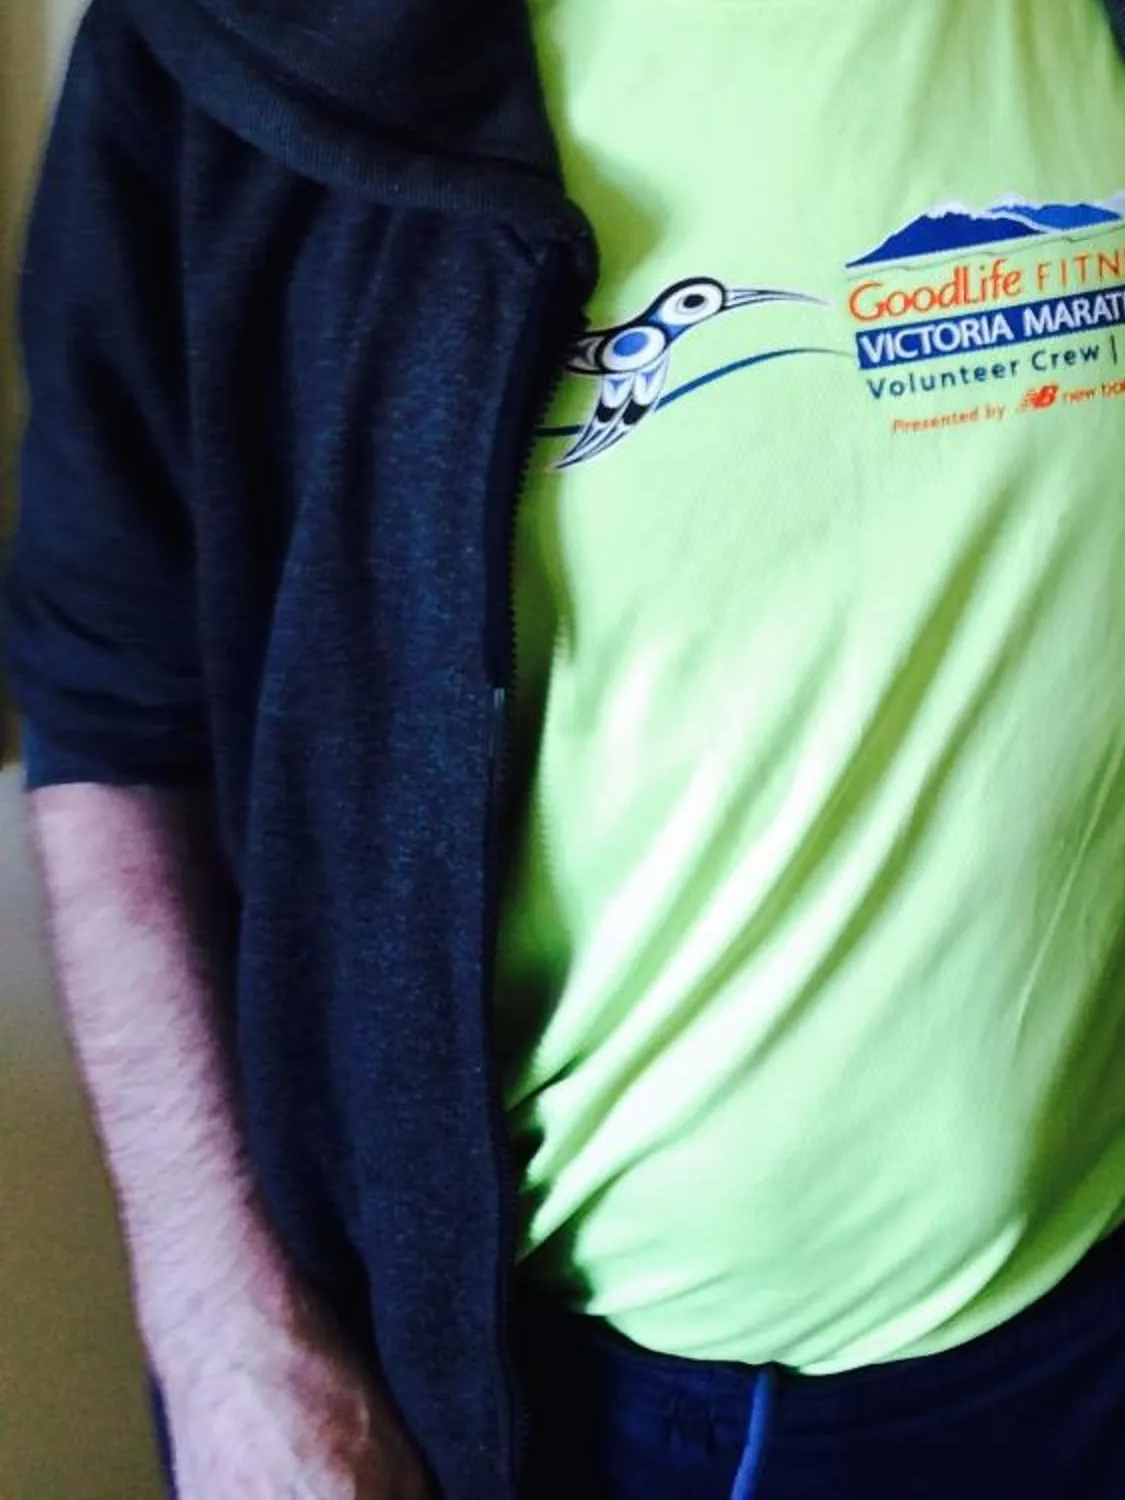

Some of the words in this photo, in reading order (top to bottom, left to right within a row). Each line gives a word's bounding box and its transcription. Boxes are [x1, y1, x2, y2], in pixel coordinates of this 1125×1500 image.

[848, 257, 1023, 324] GoodLife
[858, 315, 1014, 366] VICTORIA
[866, 357, 1020, 401] Volunteer
[1031, 343, 1100, 373] Crew
[891, 408, 980, 436] Presented
[985, 403, 1006, 423] by
[1063, 387, 1096, 405] new
